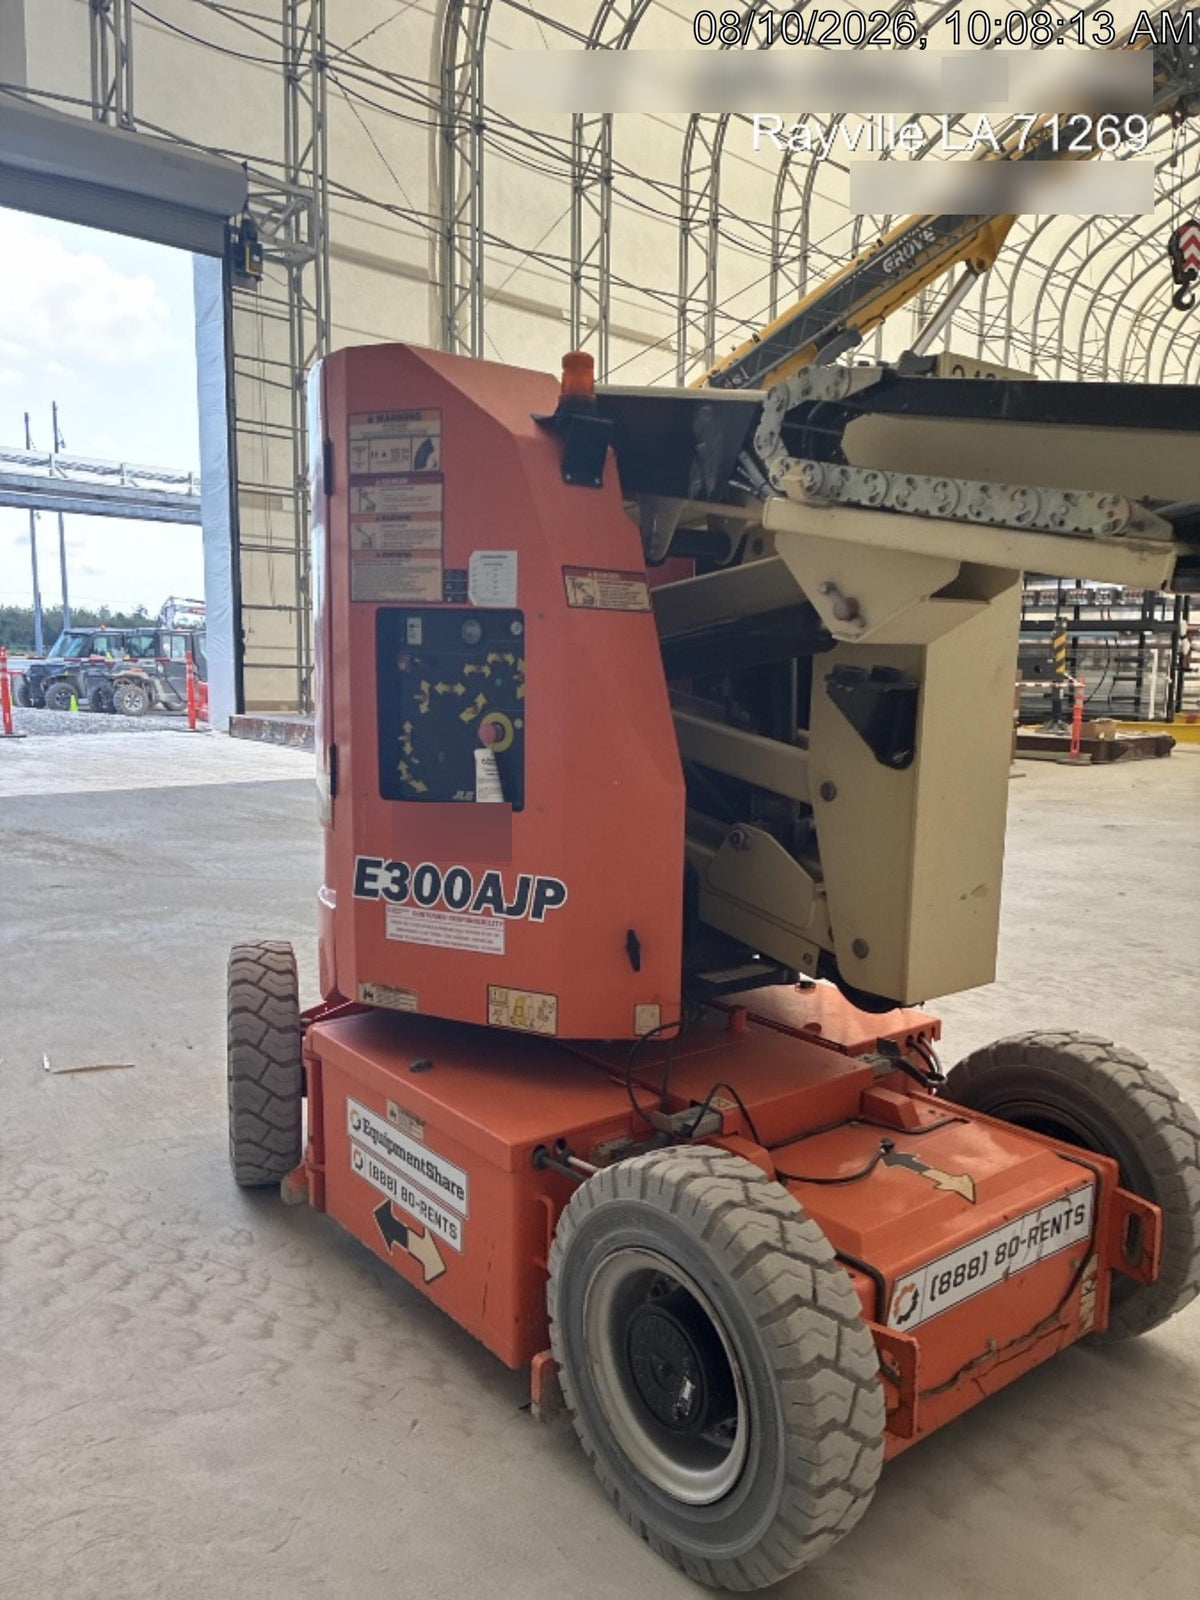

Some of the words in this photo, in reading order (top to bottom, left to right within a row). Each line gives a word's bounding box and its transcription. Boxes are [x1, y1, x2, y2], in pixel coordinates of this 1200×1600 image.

[353, 855, 567, 922] E300AJP
[362, 1117, 465, 1201] EquipmentShare
[369, 1160, 397, 1196] (888)
[401, 1184, 457, 1241] 80-RENTS
[929, 1250, 988, 1302] (888)
[994, 1203, 1086, 1266] 80-RENTS
